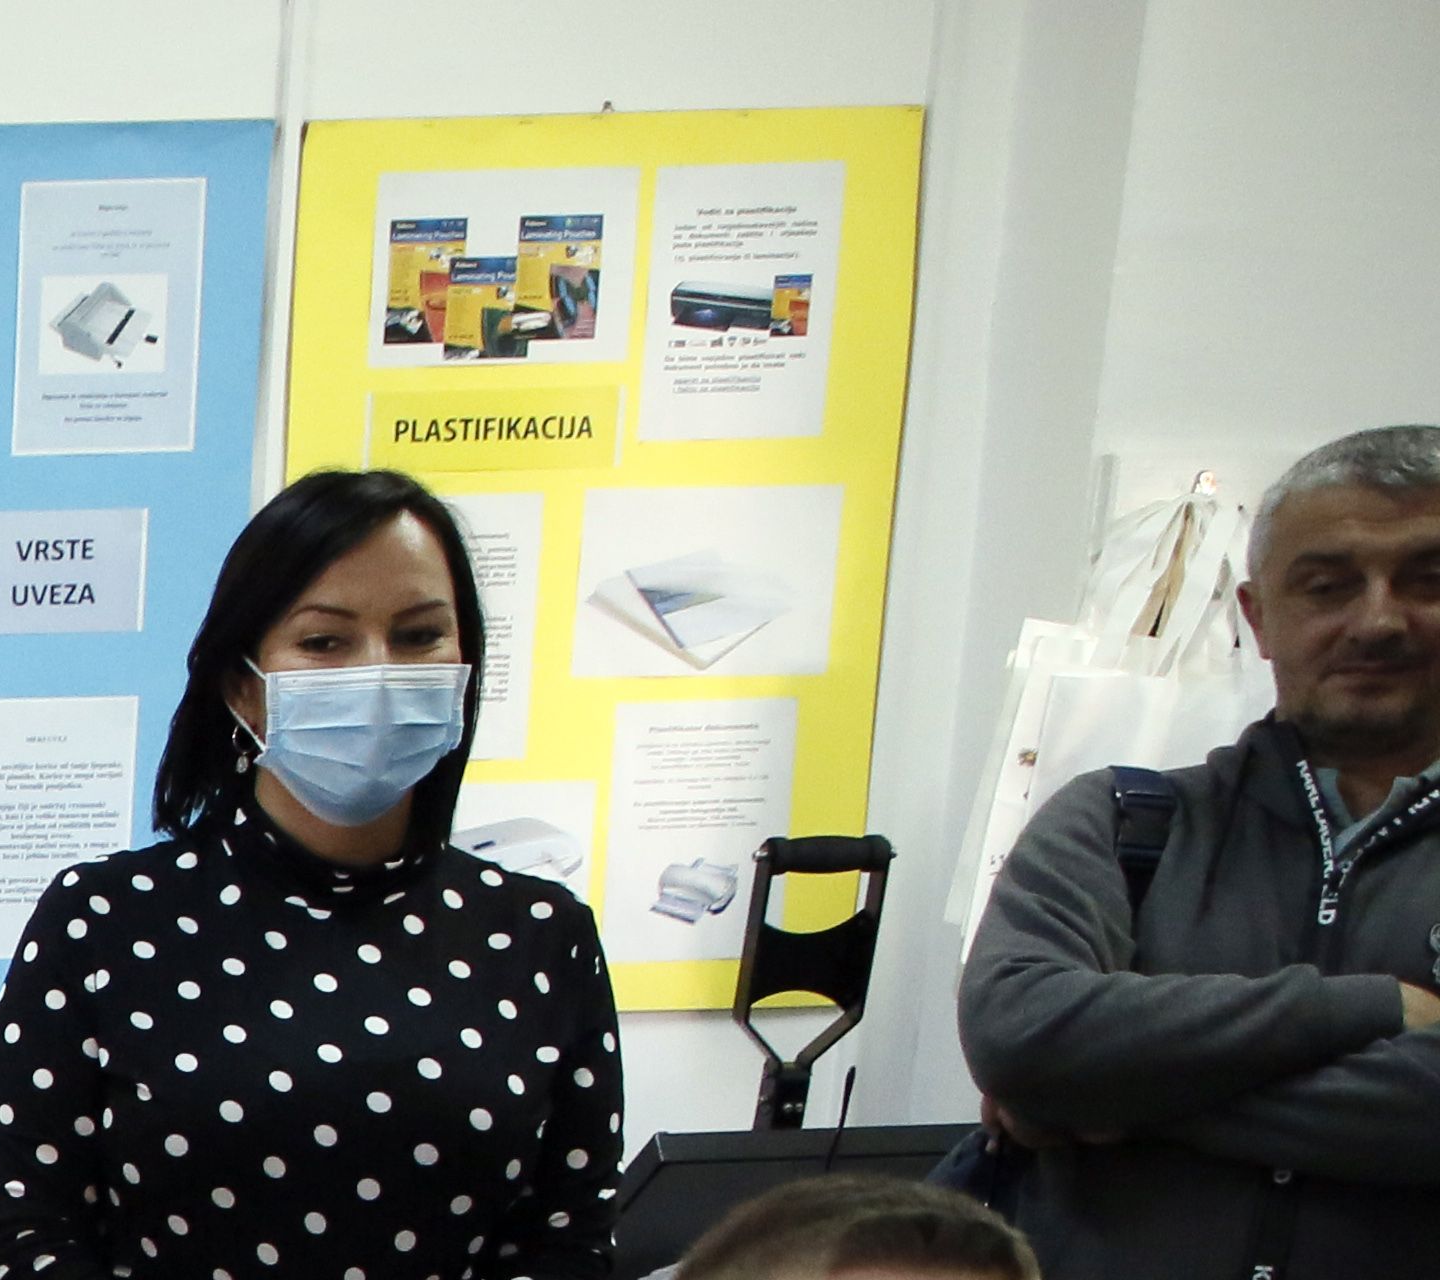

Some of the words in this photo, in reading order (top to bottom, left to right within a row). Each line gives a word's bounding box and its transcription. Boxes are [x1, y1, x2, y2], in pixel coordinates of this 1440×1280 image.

[393, 415, 594, 444] PLASTIFIKACIJA
[16, 539, 95, 563] VRSTE
[11, 583, 95, 607] UVEZA
